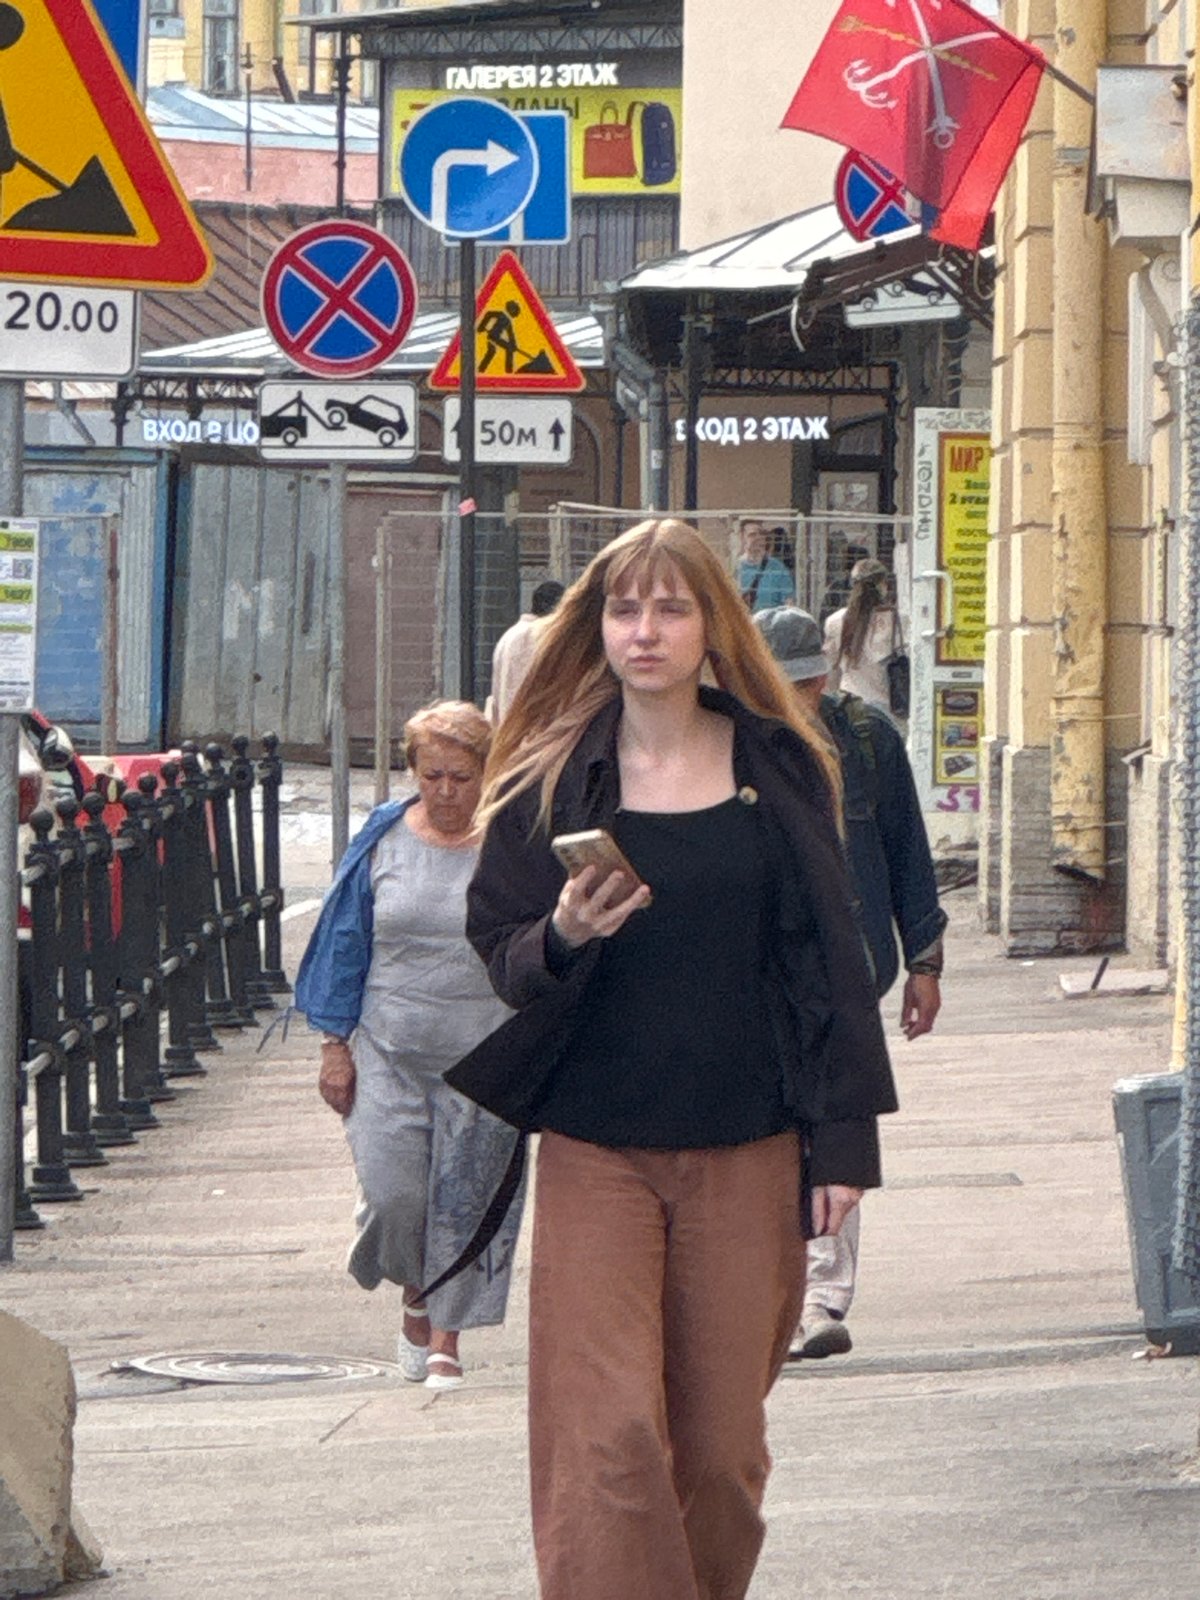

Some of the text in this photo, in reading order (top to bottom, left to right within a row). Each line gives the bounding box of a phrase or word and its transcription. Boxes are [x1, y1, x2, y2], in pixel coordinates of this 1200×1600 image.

[445, 62, 619, 89] ГАЛЕРЕЯ 2 ЭТАЖ
[4, 290, 119, 333] 20.00
[143, 419, 203, 443] ВХОД
[743, 417, 759, 441] 2
[761, 415, 830, 442] ЭТАЖ
